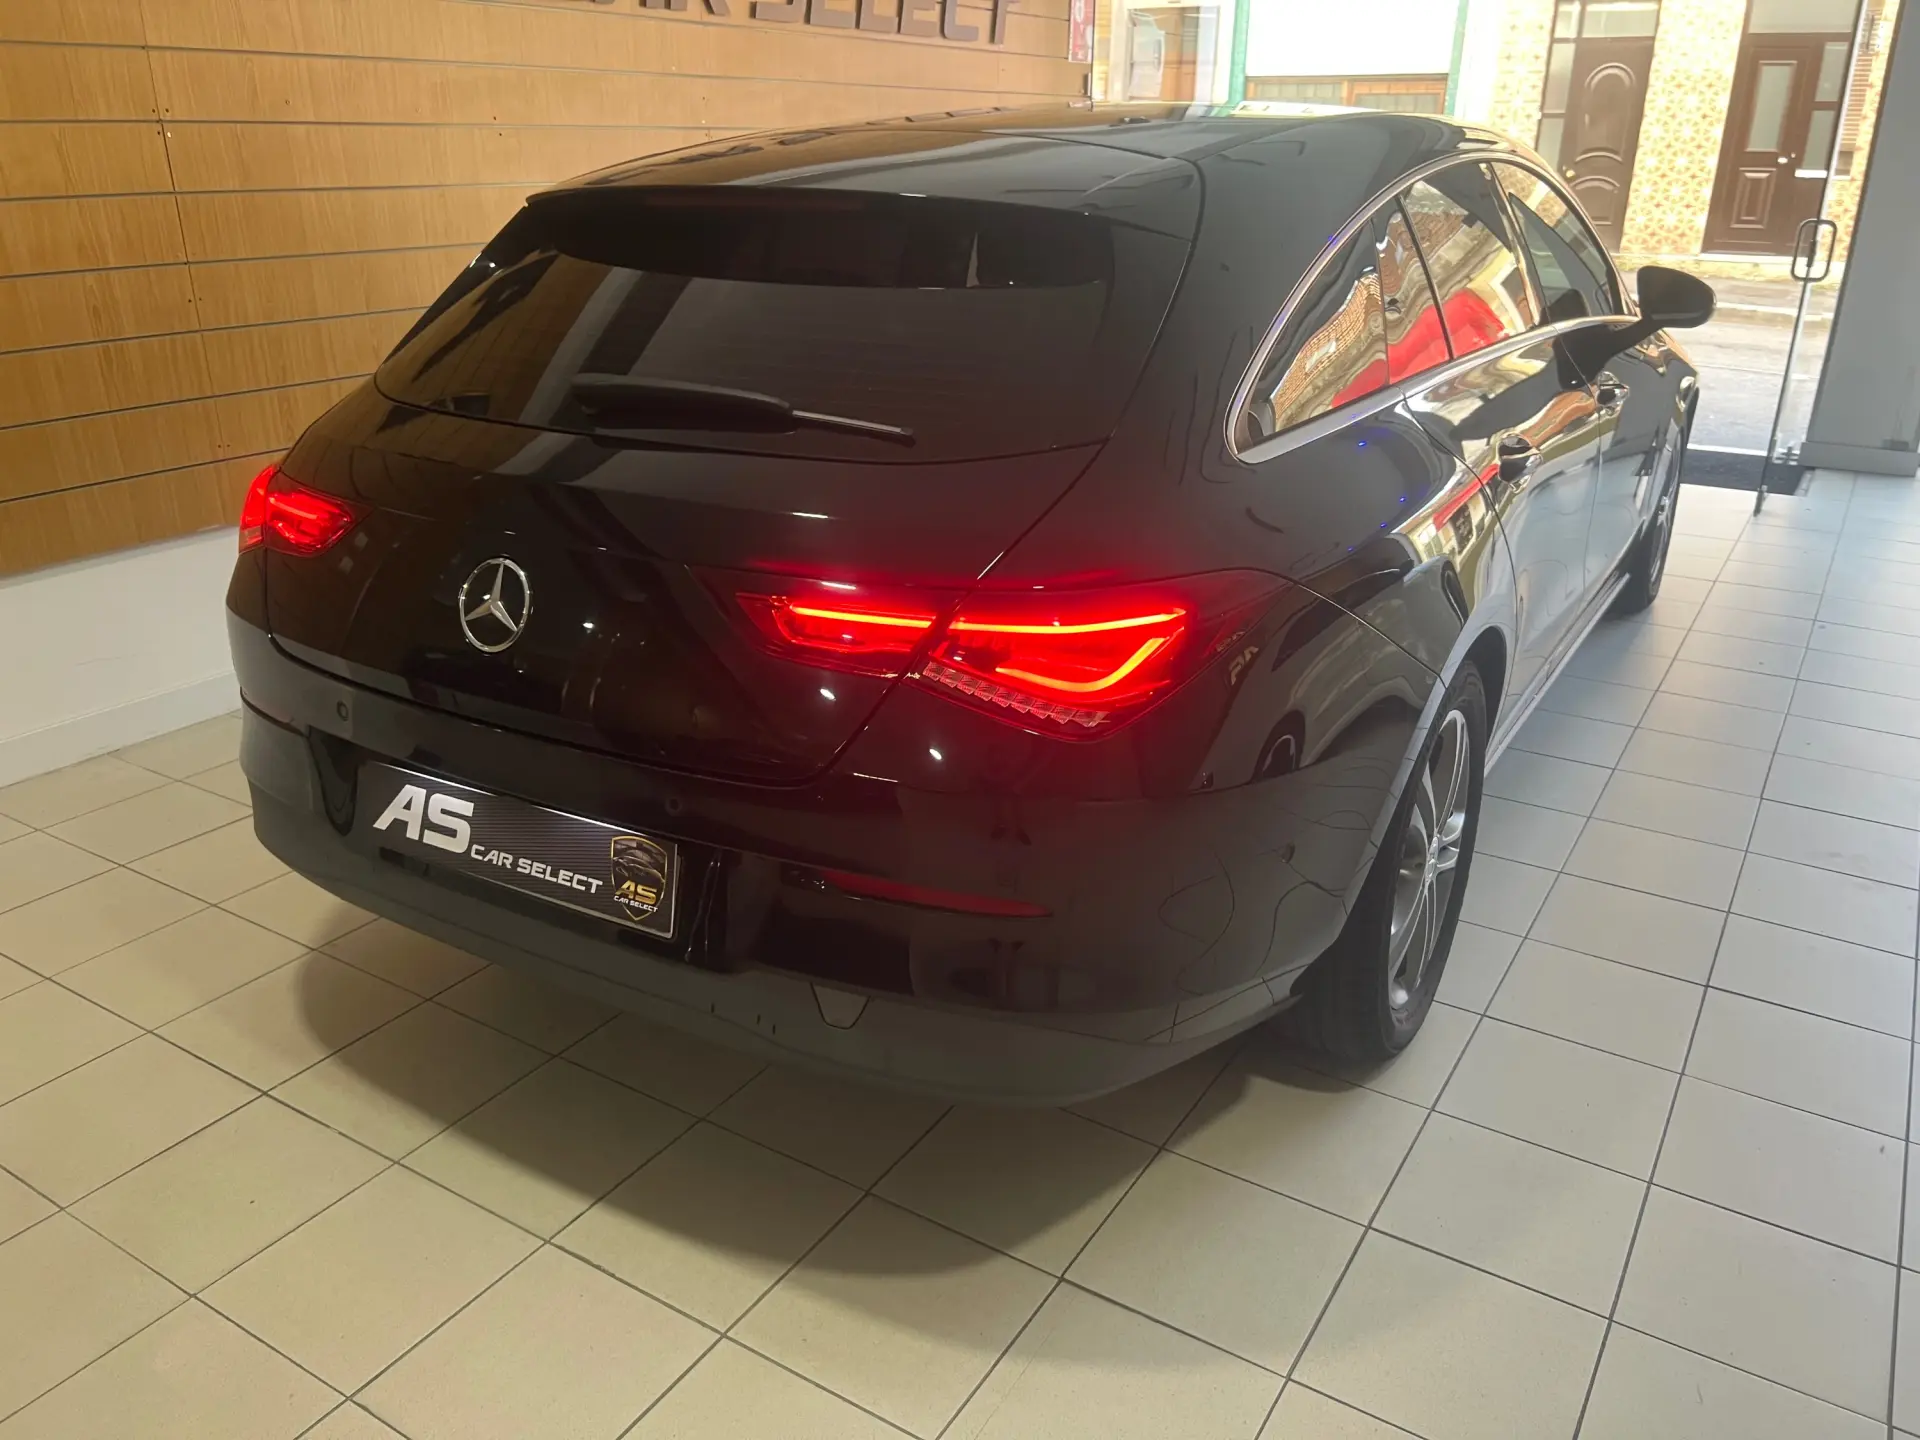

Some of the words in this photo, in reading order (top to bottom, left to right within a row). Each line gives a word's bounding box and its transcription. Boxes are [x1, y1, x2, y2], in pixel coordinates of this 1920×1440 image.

[373, 784, 474, 853] AS
[470, 844, 513, 869] CAR
[516, 857, 603, 894] SELECT
[613, 895, 629, 904] CAR
[629, 901, 658, 913] SELECT
[615, 880, 657, 904] AS
